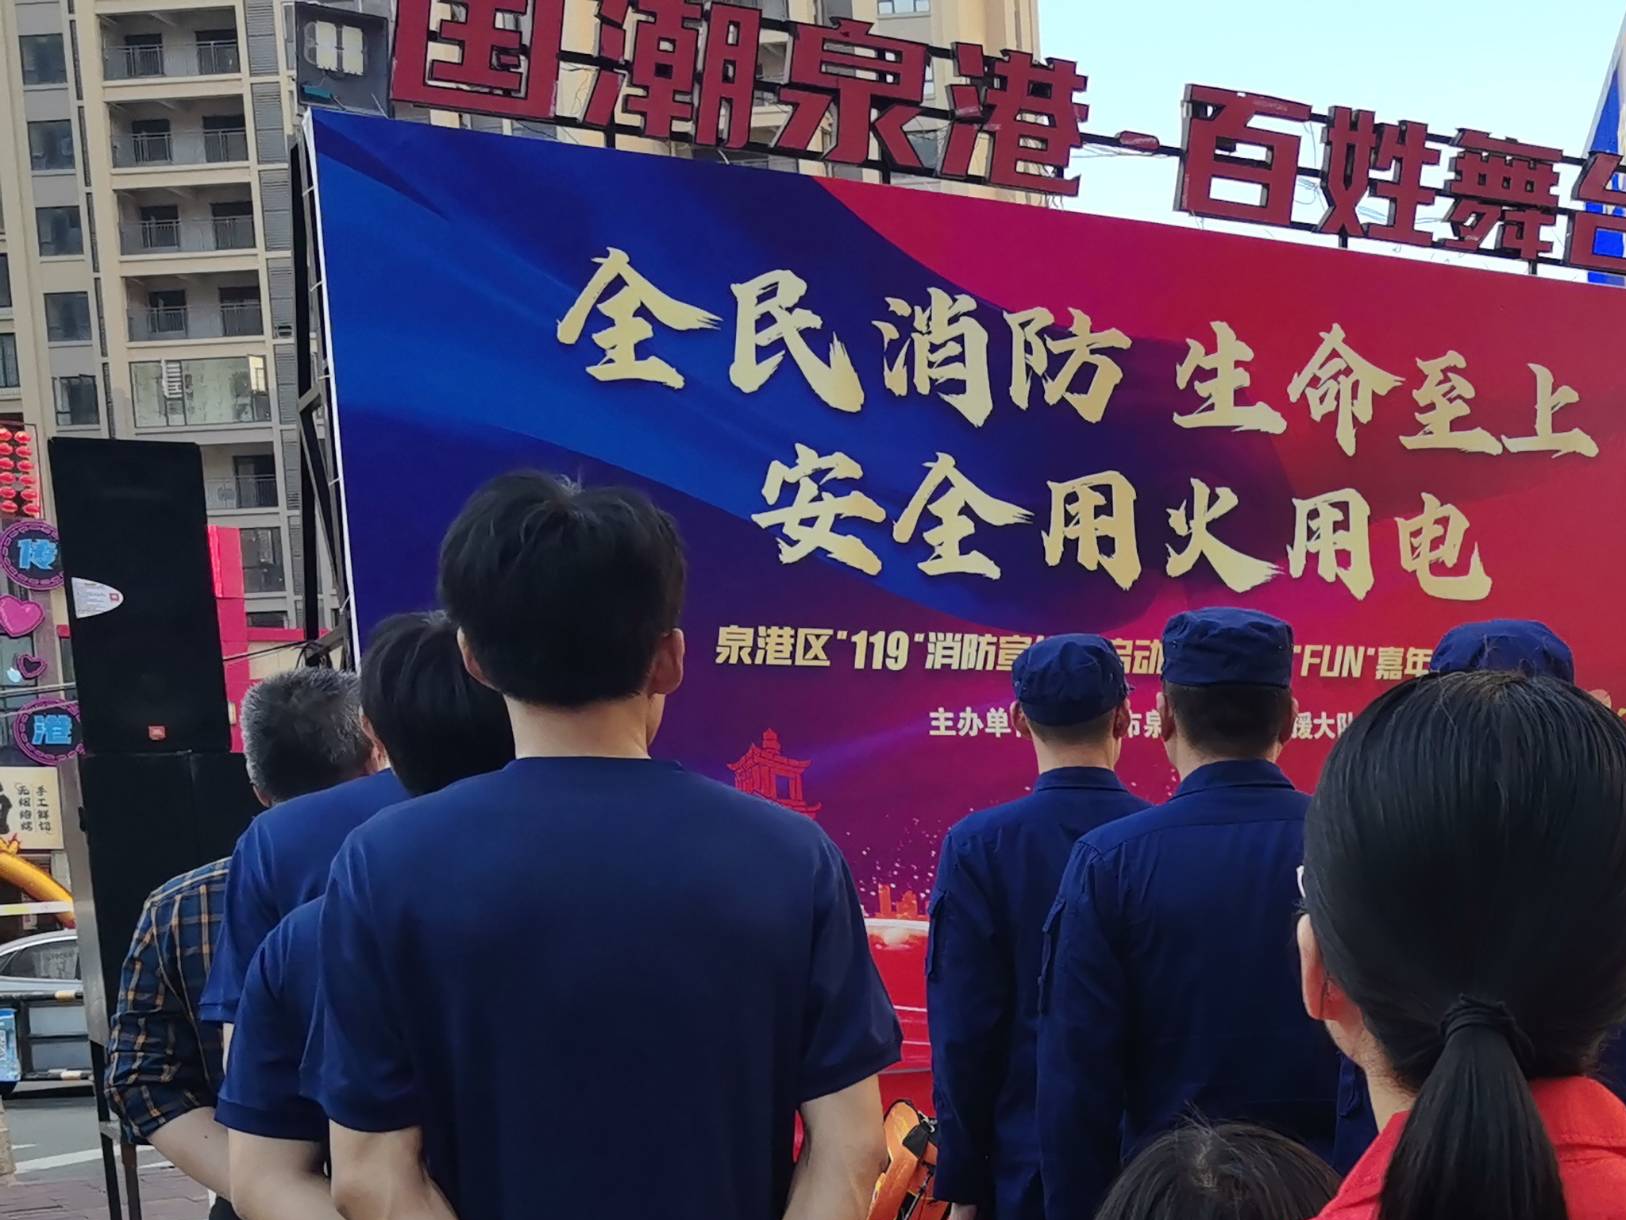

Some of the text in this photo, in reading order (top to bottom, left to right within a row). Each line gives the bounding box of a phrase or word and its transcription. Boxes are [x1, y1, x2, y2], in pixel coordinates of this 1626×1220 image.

[556, 247, 1599, 458] 全民消防 生命至上
[751, 443, 1492, 600] 安全用火用电
